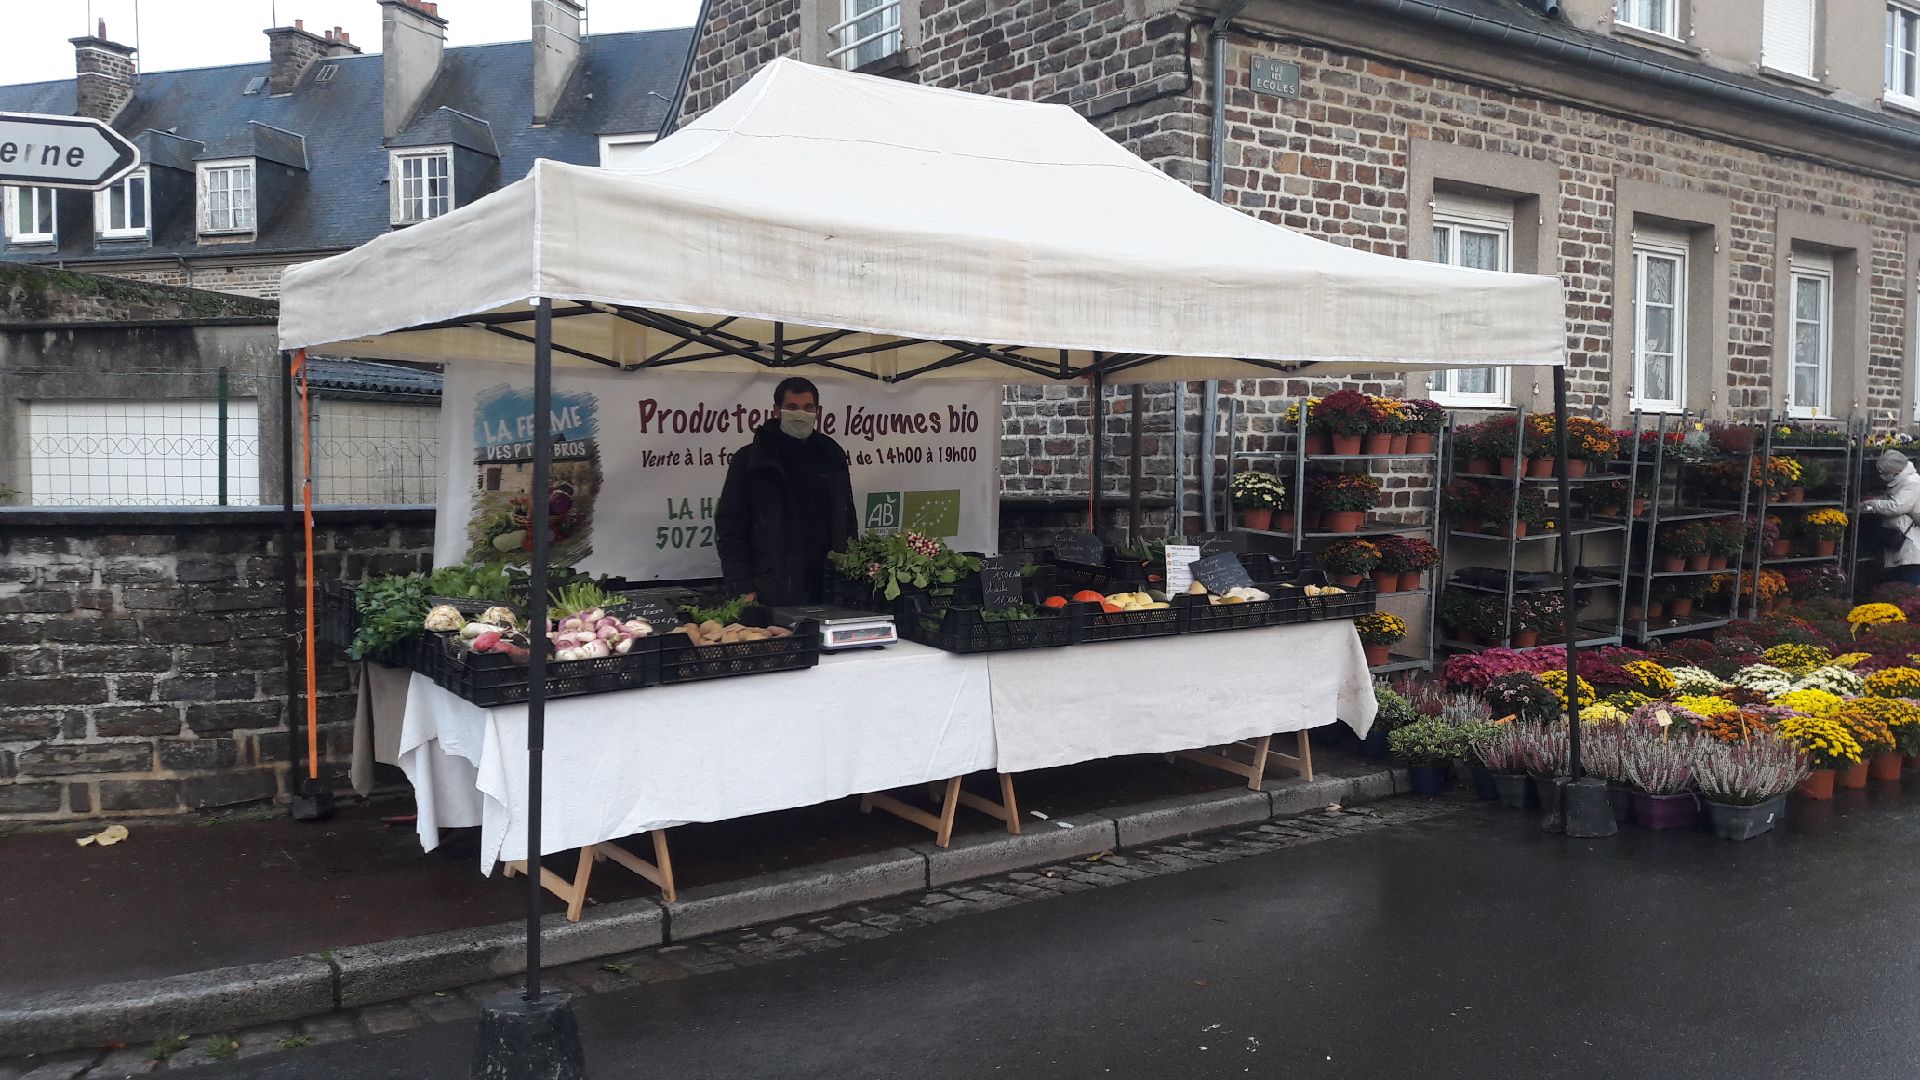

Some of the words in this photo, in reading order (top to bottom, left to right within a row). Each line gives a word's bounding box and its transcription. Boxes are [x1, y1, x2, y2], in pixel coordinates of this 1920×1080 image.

[483, 419, 512, 444] LA
[516, 406, 582, 438] FEME
[844, 405, 942, 441] légumes
[948, 404, 979, 433] bio
[487, 445, 512, 460] DES
[553, 442, 586, 457] BROS
[642, 450, 680, 468] Vente
[685, 448, 694, 466] à
[699, 447, 714, 466] la
[856, 450, 873, 465] de
[876, 447, 922, 464] 14h00
[926, 449, 933, 463] à
[667, 497, 694, 520] LA
